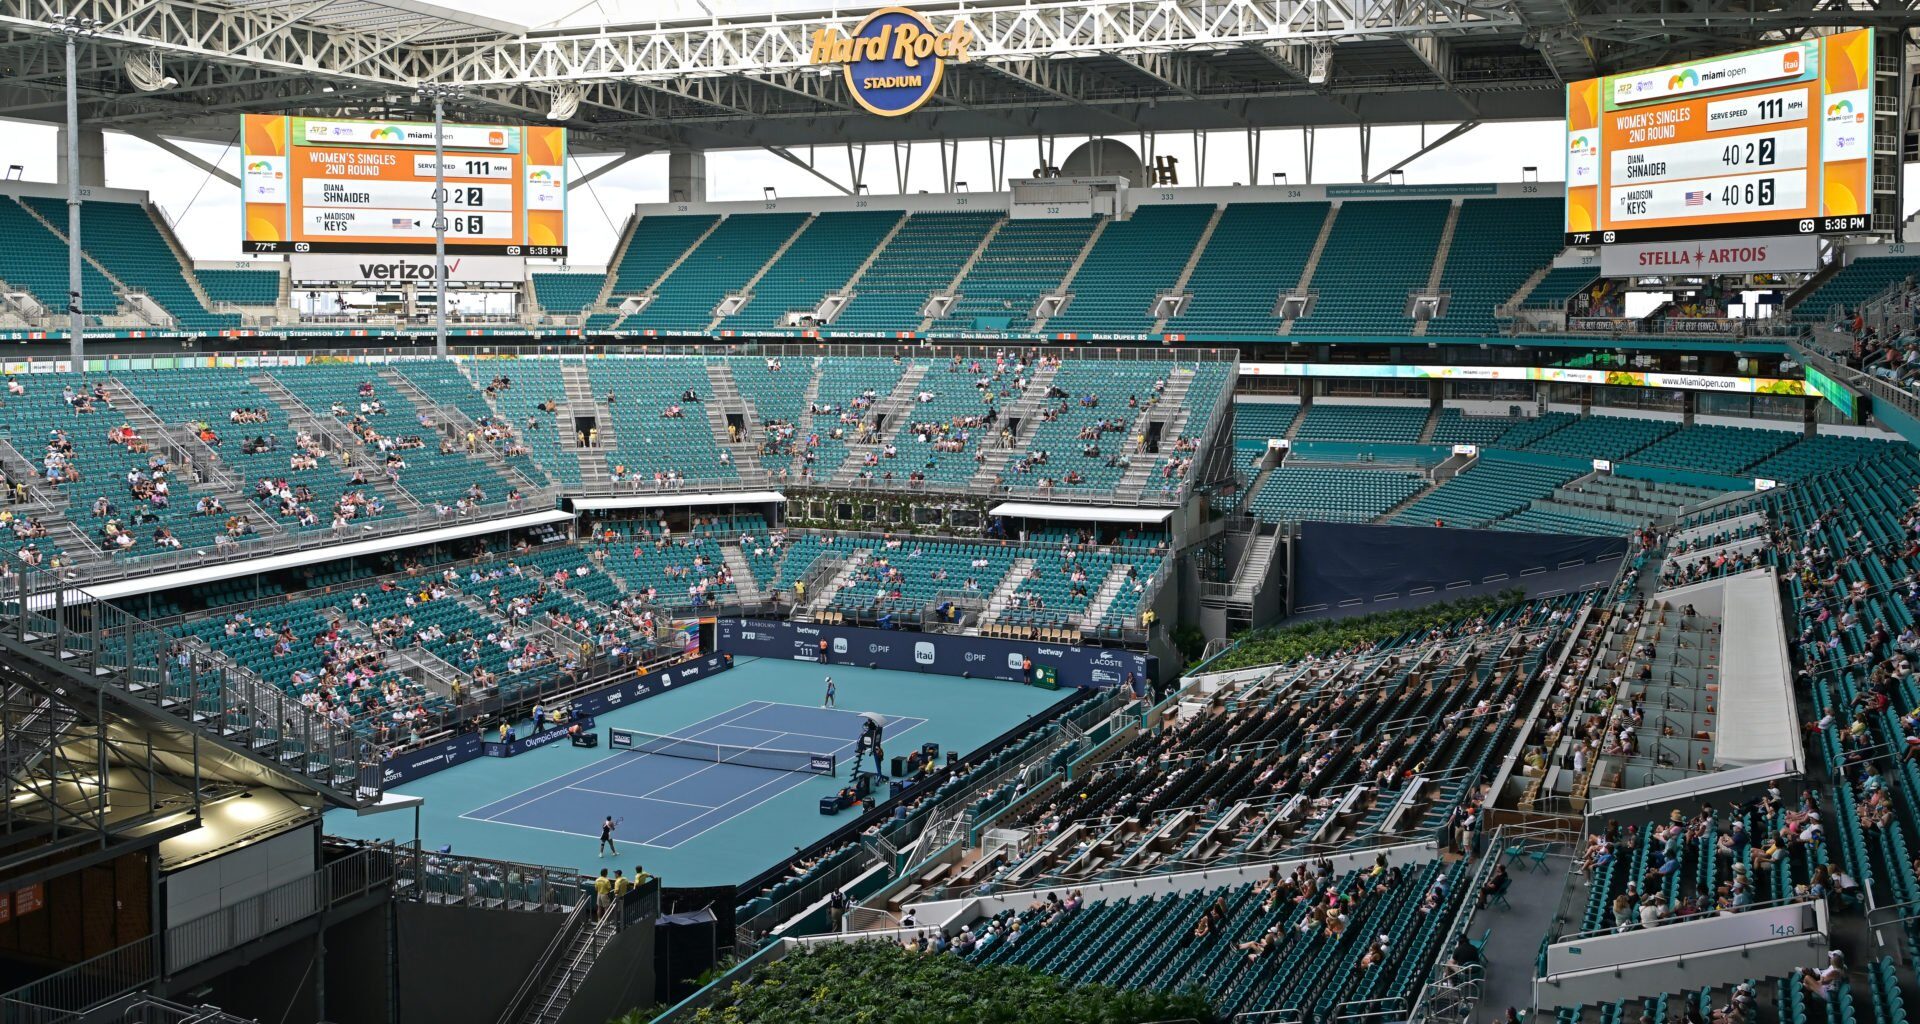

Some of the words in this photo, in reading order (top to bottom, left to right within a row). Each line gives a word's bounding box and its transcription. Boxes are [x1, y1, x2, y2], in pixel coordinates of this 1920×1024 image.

[810, 25, 892, 64] Hard
[892, 20, 973, 67] Rock
[1702, 68, 1725, 81] miami
[1727, 66, 1746, 79] open
[864, 76, 922, 90] STADIUM
[1758, 98, 1783, 120] 111
[1788, 102, 1802, 110] MPH
[1617, 113, 1654, 130] WOMEN'S
[1656, 108, 1690, 124] SINGLES
[1711, 111, 1727, 121] SERVE
[1729, 109, 1747, 119] SPEED
[1630, 128, 1647, 142] 2ND
[1648, 125, 1675, 141] ROUND
[1723, 145, 1739, 166] 40
[1745, 143, 1754, 164] 2
[1762, 141, 1772, 162] 2
[310, 152, 355, 164] WOMEN'S
[358, 154, 396, 165] SINGLES
[1628, 154, 1644, 165] DIANA
[326, 164, 343, 175] 2ND
[347, 165, 380, 176] ROUND
[466, 161, 489, 175] 111
[1627, 162, 1666, 178] SHNAIDER
[324, 191, 370, 203] SHNAIDER
[454, 189, 463, 203] 2
[471, 190, 480, 204] 2
[1627, 190, 1653, 201] MADISON
[1722, 185, 1739, 206] 40
[1745, 184, 1754, 204] 6
[1762, 182, 1772, 203] 5
[1627, 202, 1646, 215] KEYS
[324, 212, 355, 220] MADISON
[324, 220, 347, 231] KEYS
[455, 217, 463, 232] 6
[471, 218, 480, 232] 5
[1801, 221, 1814, 231] CC
[1825, 218, 1847, 230] 5:36
[1850, 217, 1864, 229] PM
[1574, 234, 1590, 244] 77°F
[1605, 232, 1614, 242] CC
[255, 242, 277, 251] 77°F
[1889, 245, 1904, 253] 340
[1639, 247, 1690, 265] STELLA
[1708, 246, 1766, 263] ARTOIS
[1662, 376, 1735, 389] www.MiamiOpen.com
[796, 626, 820, 636] betway
[800, 648, 813, 656] 111
[917, 649, 933, 660] itaú
[1038, 648, 1063, 657] betway
[1090, 658, 1122, 667] LACOSTE
[681, 667, 699, 677] betway
[383, 772, 403, 783] ACOSTE
[1769, 924, 1795, 936] 148
